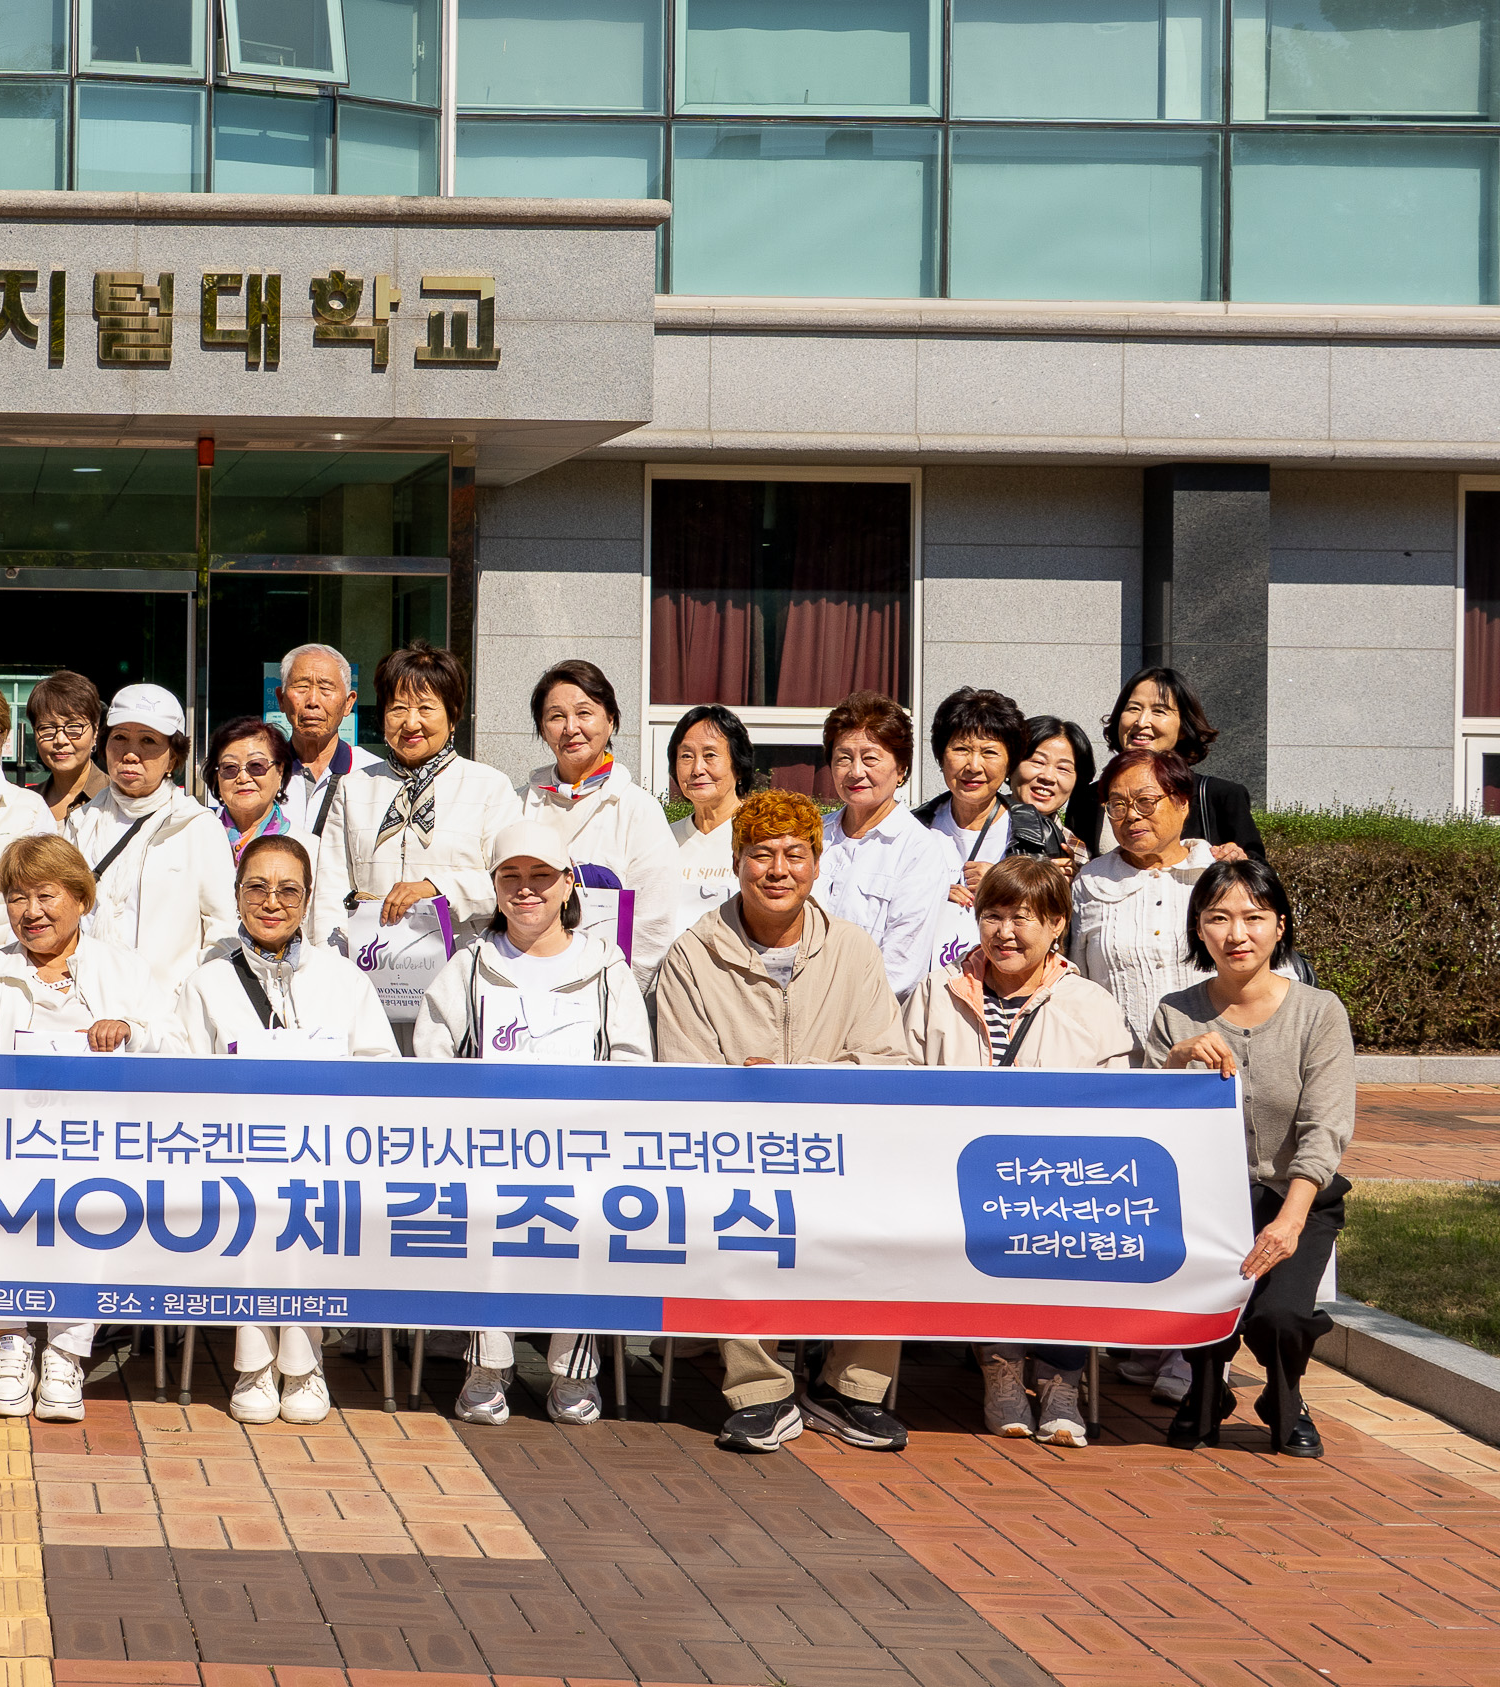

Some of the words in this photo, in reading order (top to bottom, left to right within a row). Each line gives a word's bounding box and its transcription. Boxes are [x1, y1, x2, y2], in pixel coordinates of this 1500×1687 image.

[377, 987, 425, 995] WONKWANG
[115, 1121, 330, 1166] 타슈켄트시
[345, 1125, 610, 1172] 야카사라이구
[622, 1131, 845, 1176] 고려인협회
[995, 1157, 1138, 1187] 타슈켄트시
[982, 1195, 1160, 1227] 야카사라이구
[1004, 1230, 1145, 1262] 고려인협회
[96, 1291, 142, 1314] 장소
[162, 1294, 349, 1317] 원광디지털대학교
